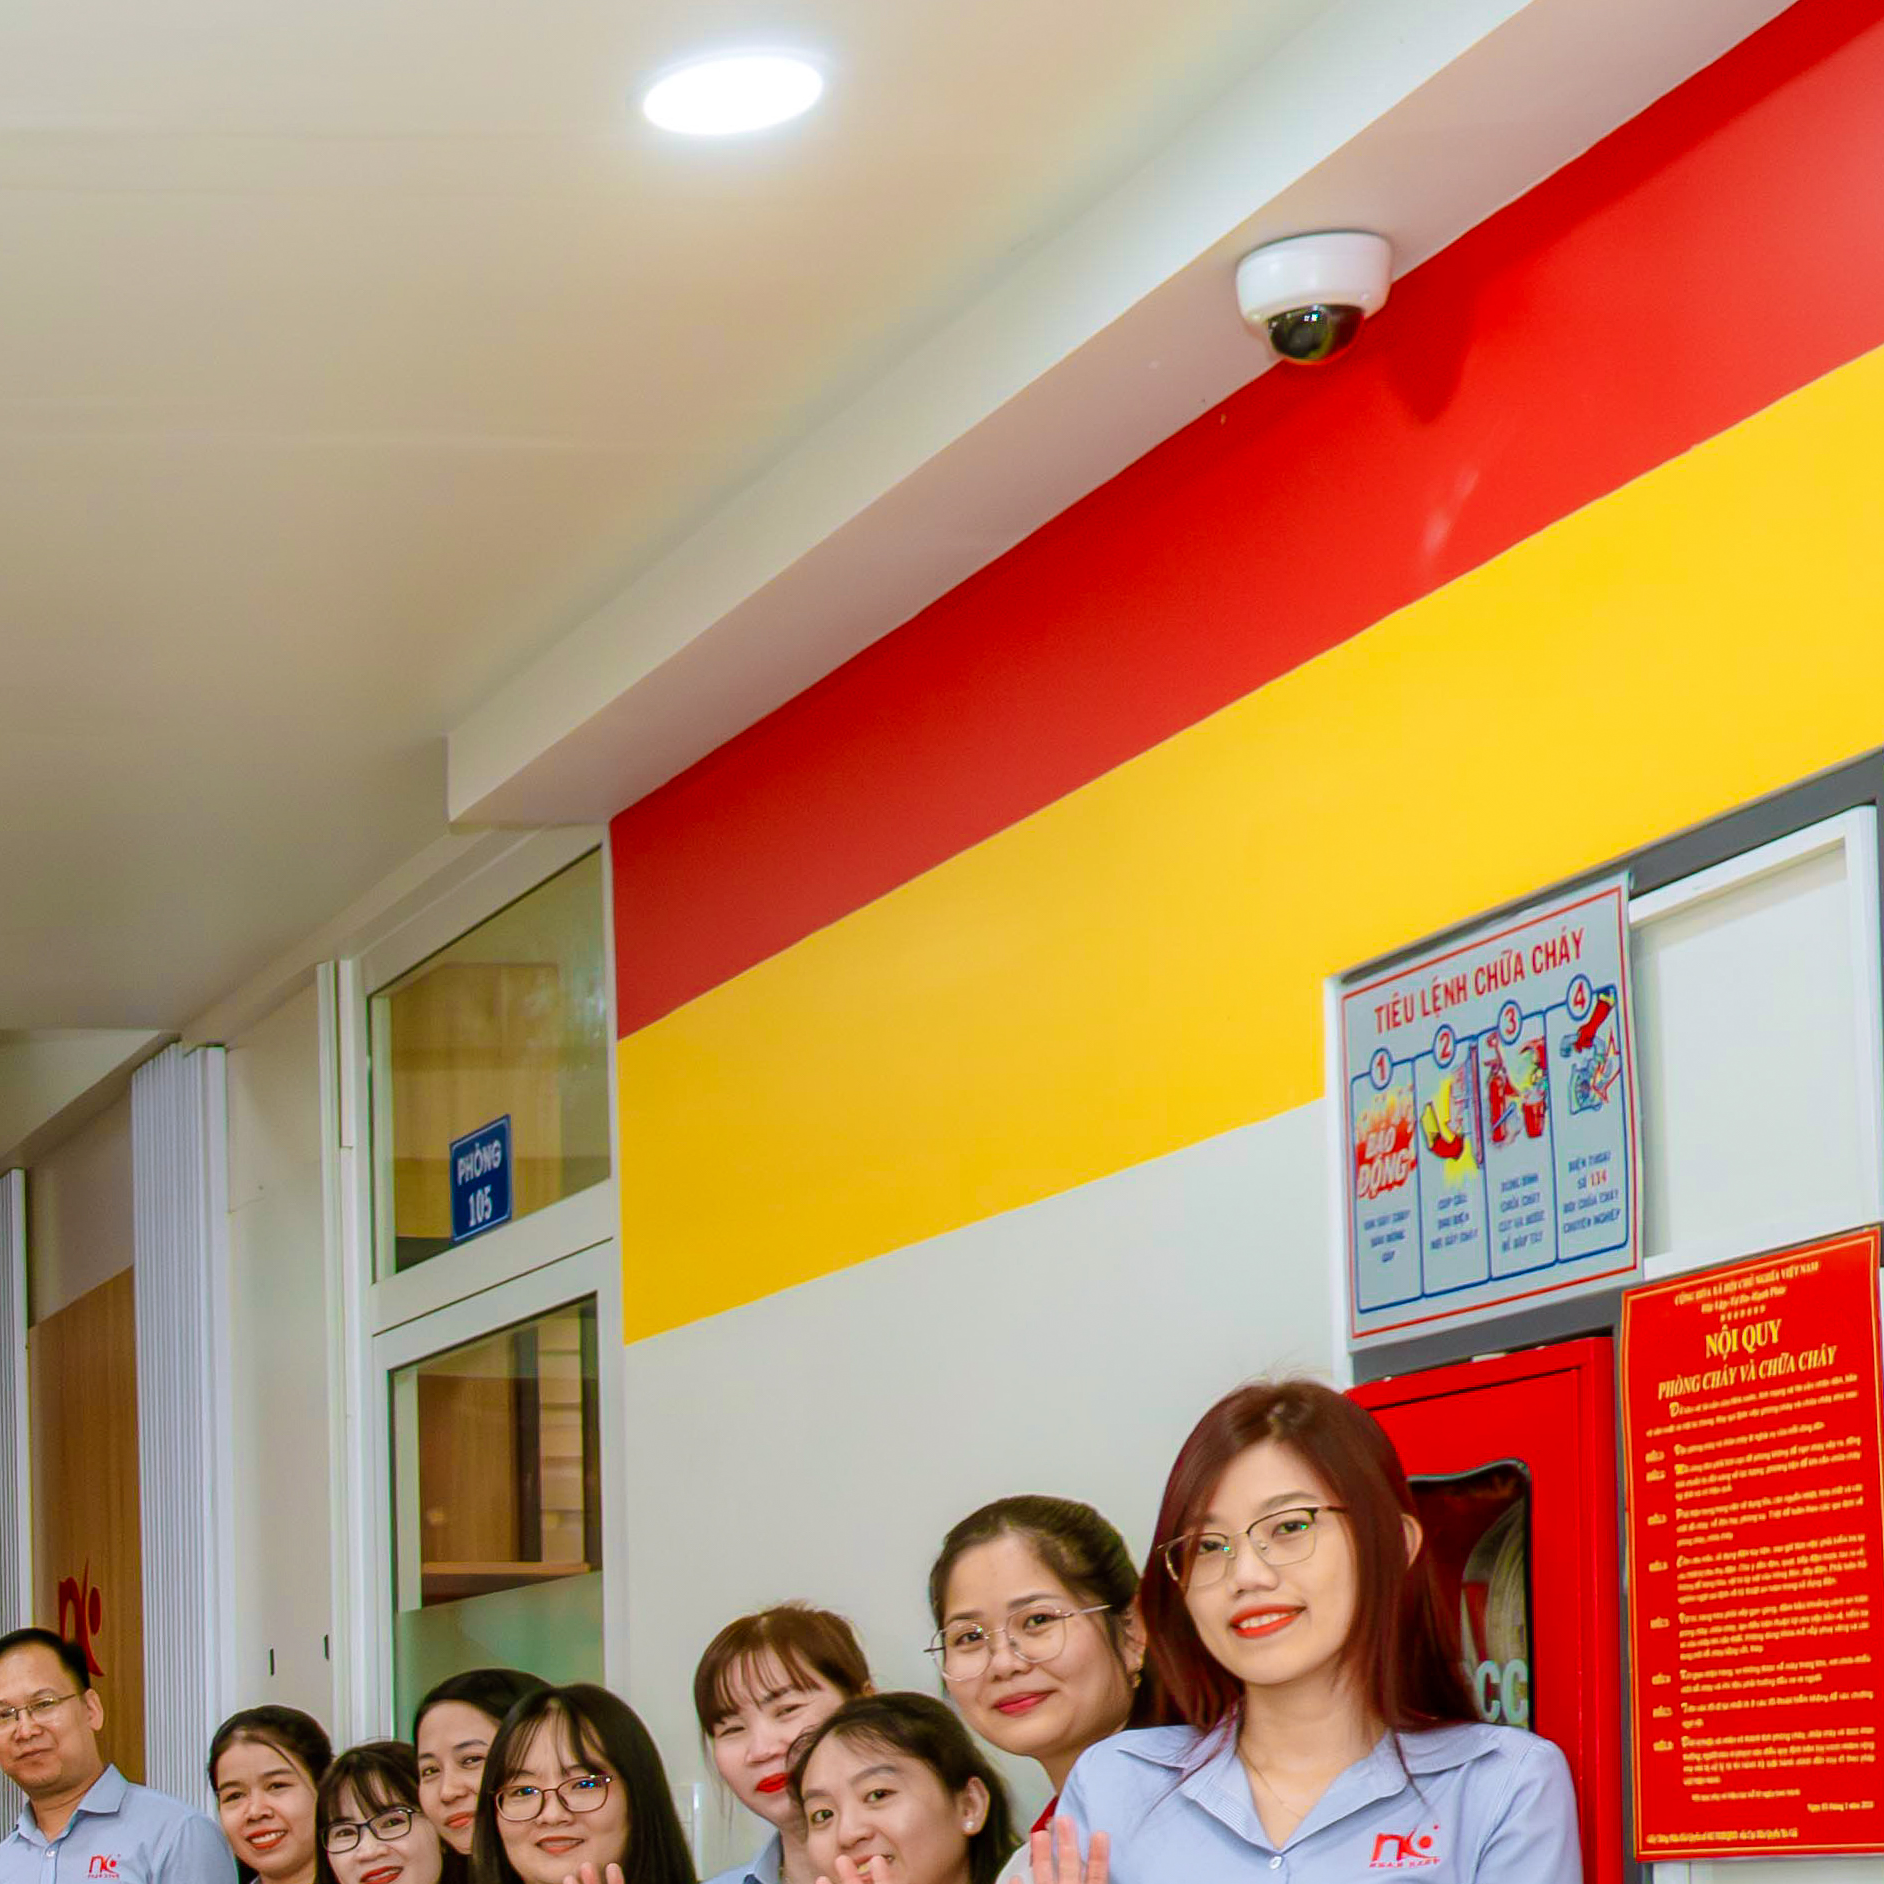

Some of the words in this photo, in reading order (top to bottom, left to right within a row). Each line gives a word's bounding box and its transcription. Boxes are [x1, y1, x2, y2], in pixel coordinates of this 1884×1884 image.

[1375, 992, 1415, 1034] TIÊU
[1421, 977, 1468, 1018] LỆNH
[1474, 948, 1526, 995] CHỮA
[1532, 926, 1585, 975] CHÁY
[1571, 981, 1585, 1010] 4
[1503, 1006, 1517, 1035] 3
[1439, 1031, 1451, 1059] 2
[1376, 1055, 1386, 1080] 1
[457, 1139, 502, 1186] PHÒNG
[1705, 1325, 1738, 1360] NỘI
[1742, 1318, 1782, 1354] QUY
[1658, 1372, 1700, 1400] PHÒNG
[1702, 1362, 1738, 1391] CHÁY
[1739, 1358, 1757, 1384] VÀ
[1758, 1351, 1796, 1382] CHỮA
[1798, 1343, 1838, 1371] CHÁY
